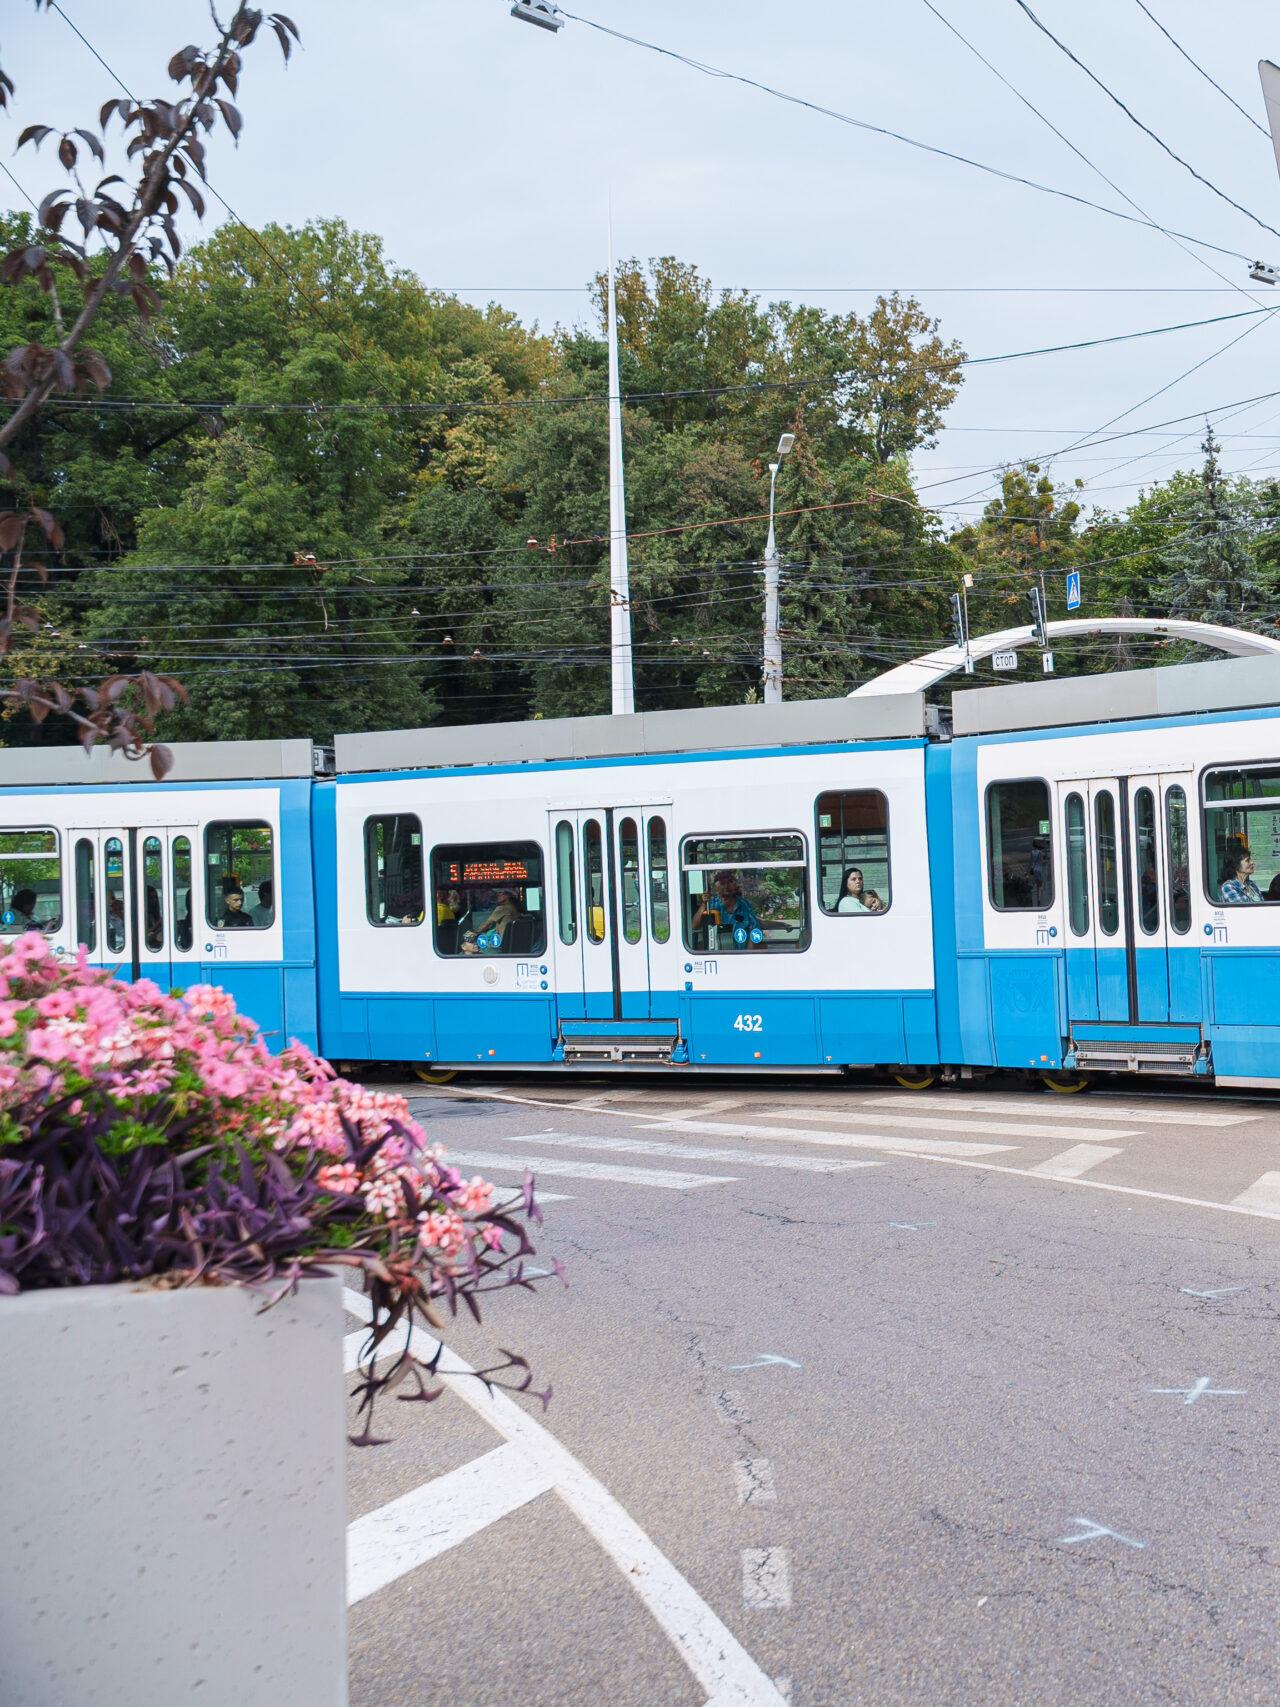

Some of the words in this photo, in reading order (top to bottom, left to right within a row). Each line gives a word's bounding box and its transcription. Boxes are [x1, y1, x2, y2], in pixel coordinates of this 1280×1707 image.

[995, 655, 1015, 667] СТОП
[449, 863, 459, 882] 5
[733, 1014, 763, 1032] 432
